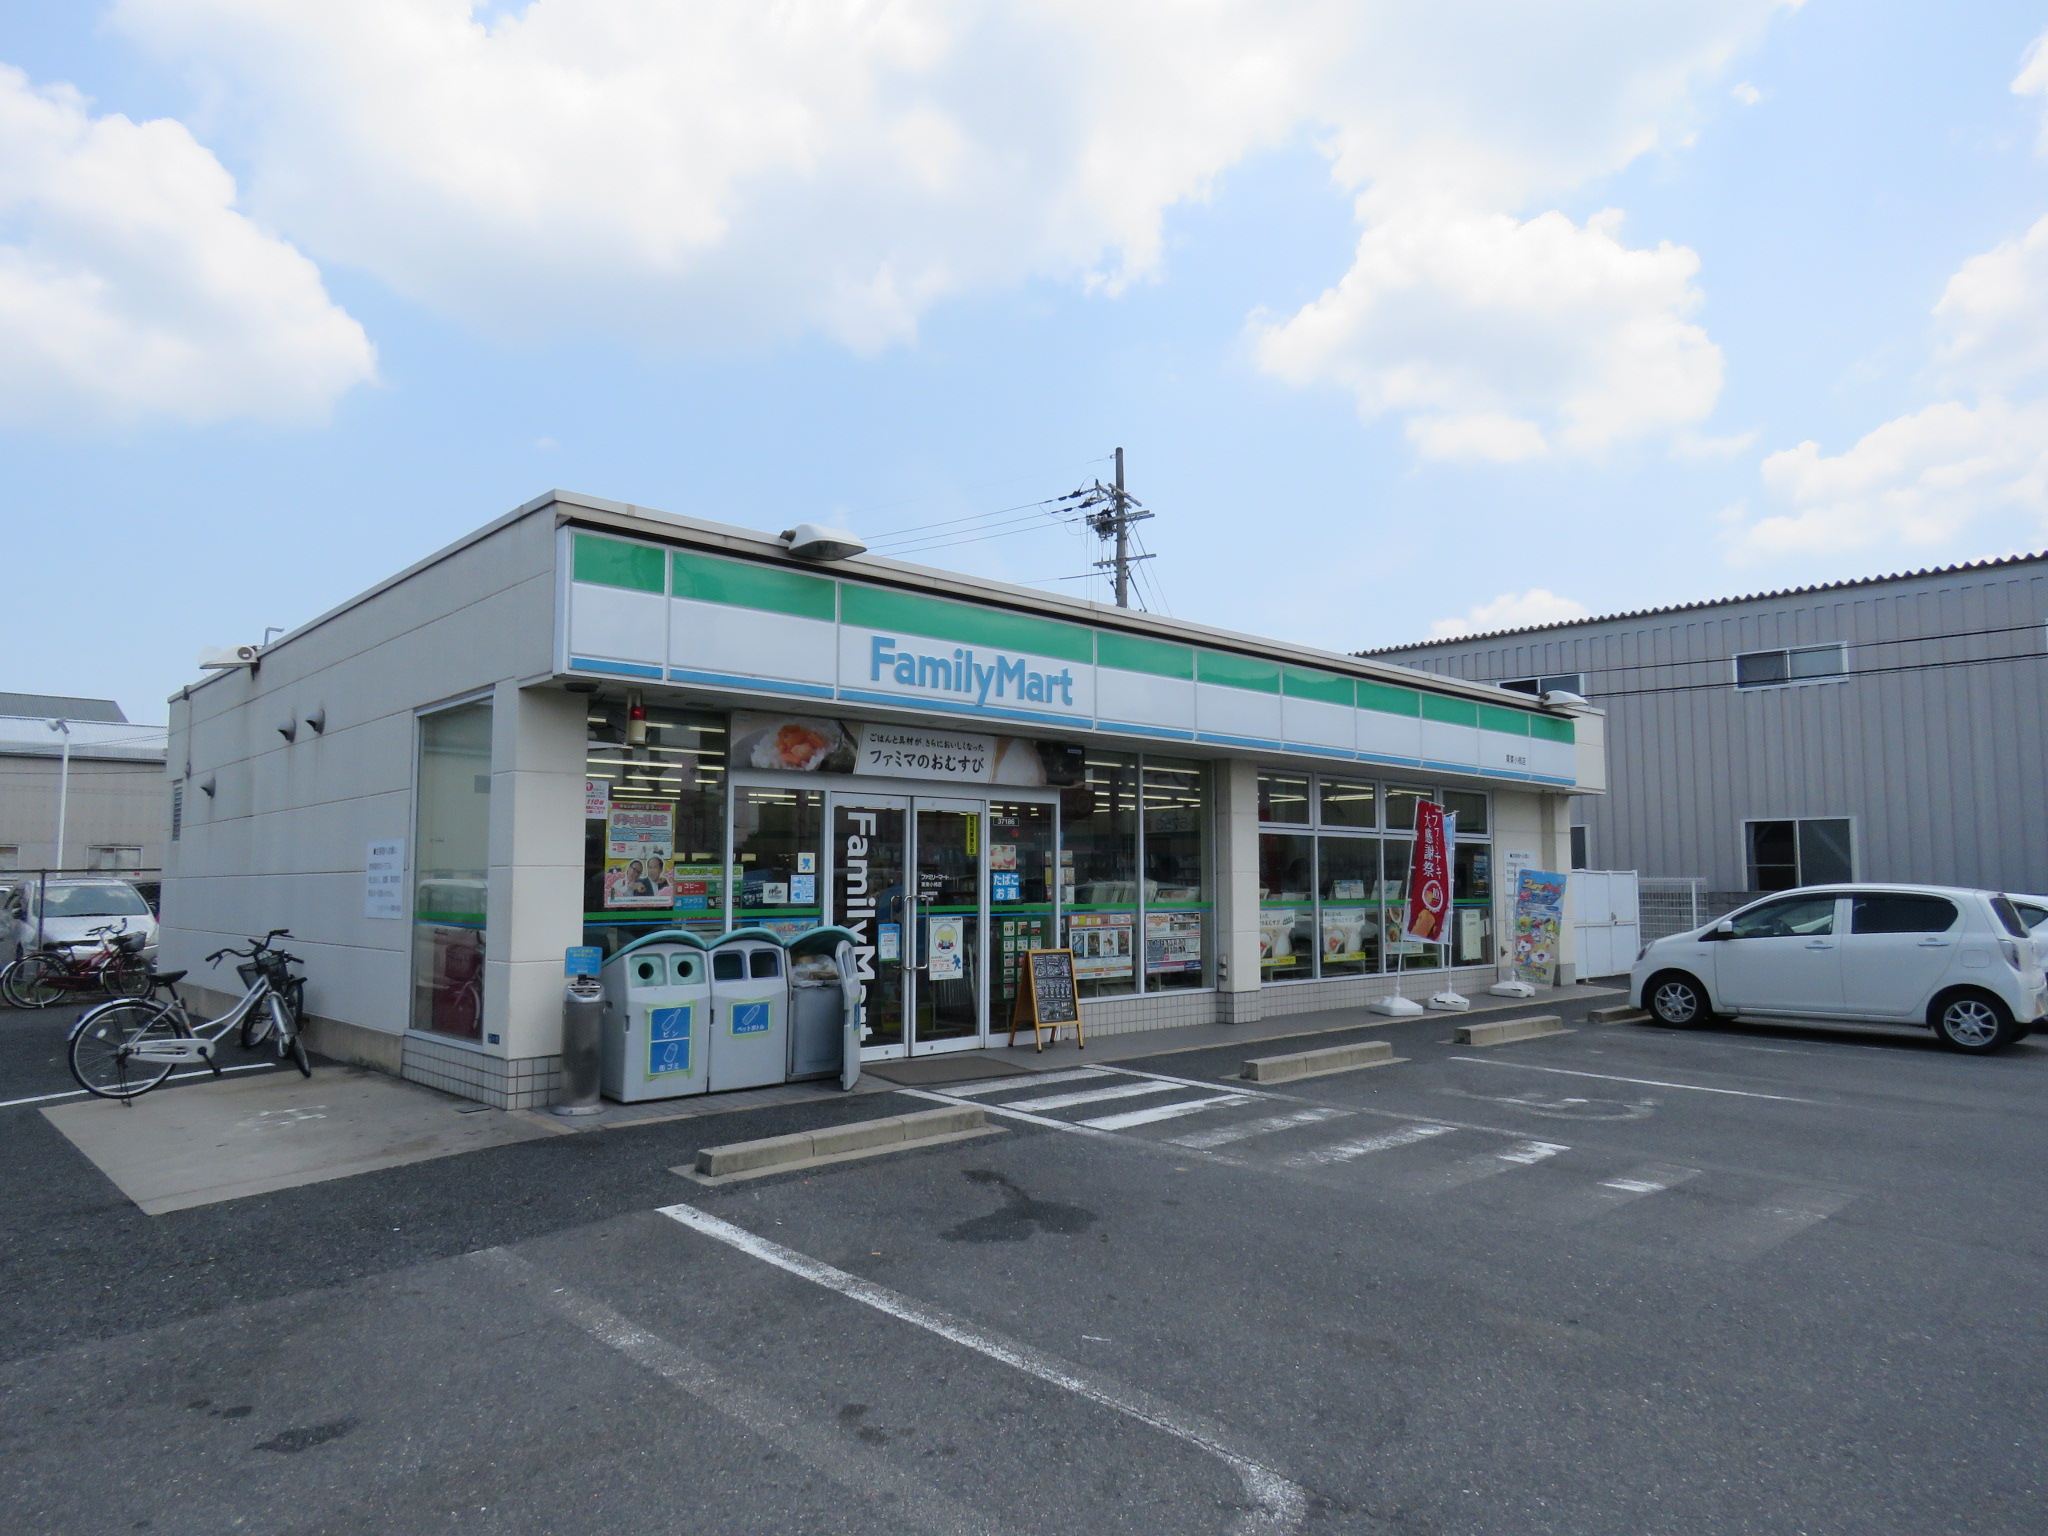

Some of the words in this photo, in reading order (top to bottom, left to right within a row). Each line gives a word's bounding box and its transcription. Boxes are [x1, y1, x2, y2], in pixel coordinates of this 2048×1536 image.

[870, 636, 1073, 706] FamilyMart
[870, 750, 984, 773] ファミマのおむすび
[1423, 811, 1435, 878] 大感謝祭
[993, 874, 1019, 886] たばこ
[996, 887, 1016, 899] お酒
[736, 1024, 765, 1032] ペットボトル
[658, 1063, 680, 1072] 缶ゴミ
